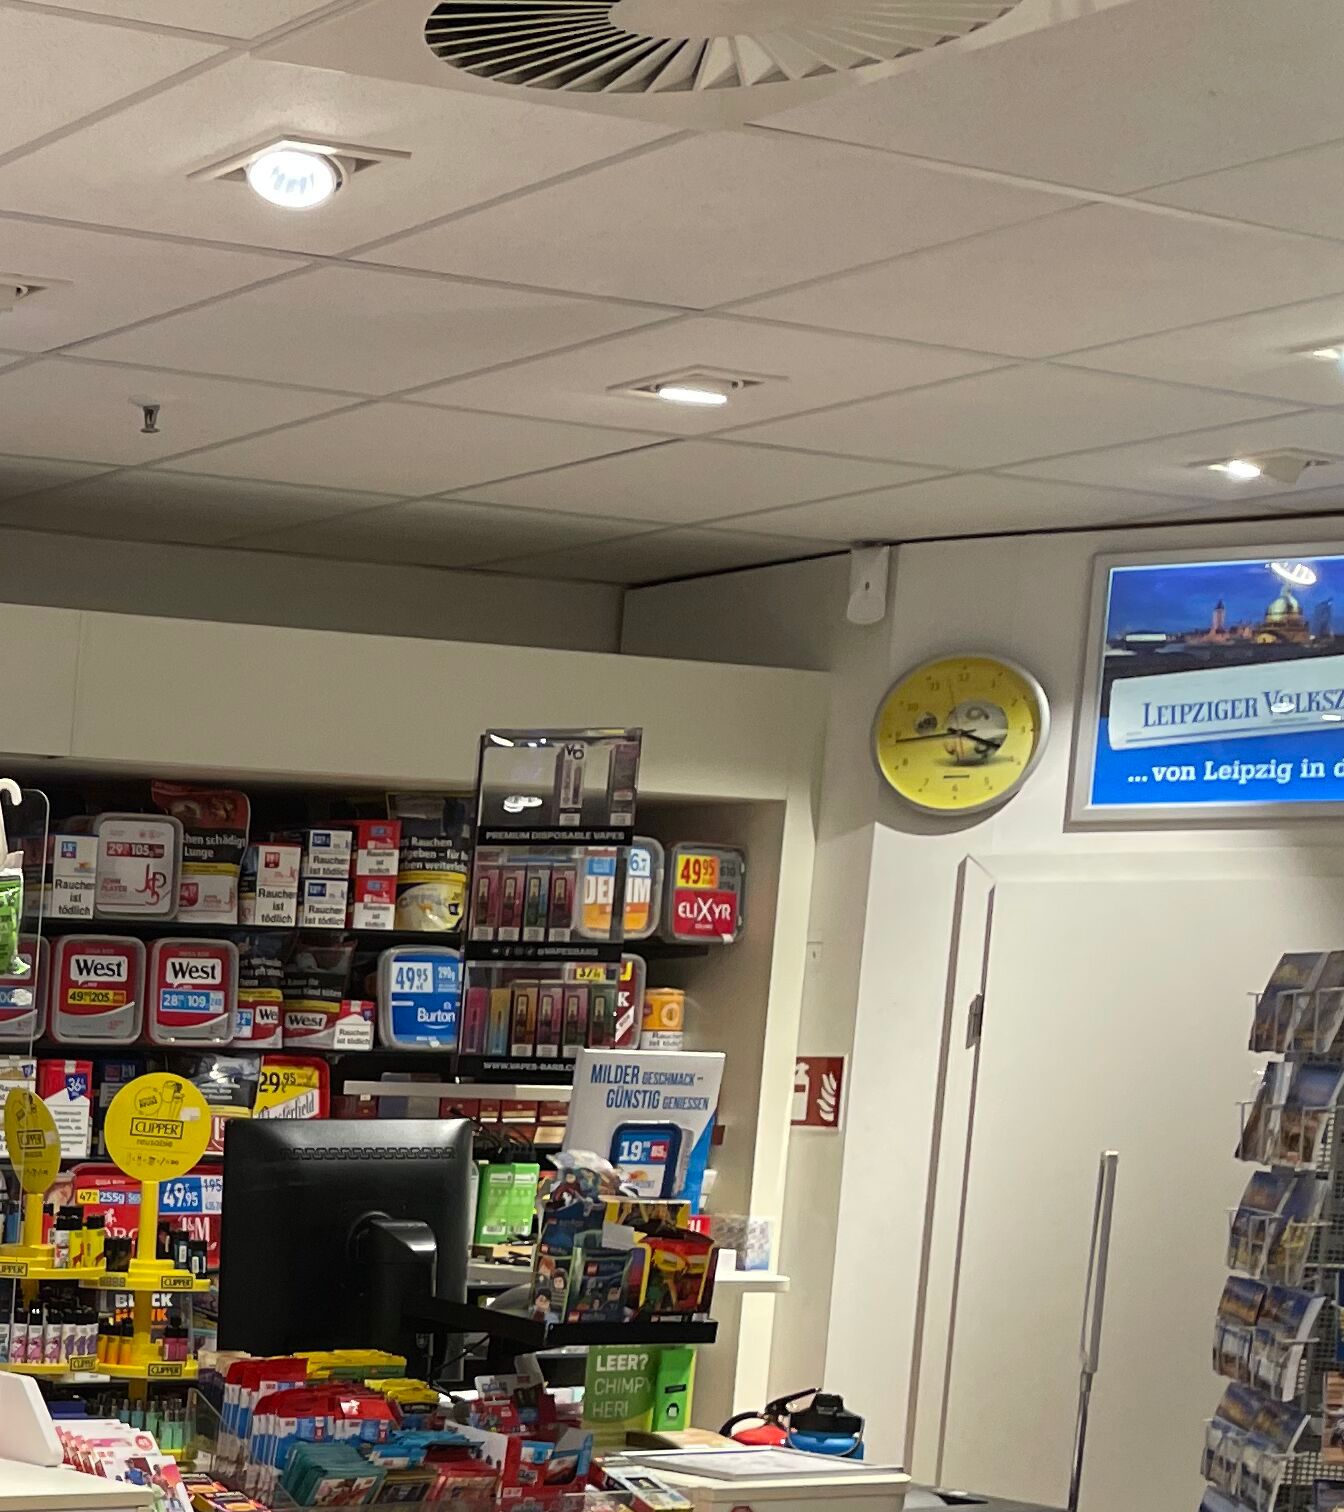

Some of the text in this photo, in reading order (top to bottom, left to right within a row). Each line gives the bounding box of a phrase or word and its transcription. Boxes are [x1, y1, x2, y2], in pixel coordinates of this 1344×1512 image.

[1143, 698, 1258, 728] LEIPZIGER
[1204, 759, 1293, 784] Leipzig
[1300, 758, 1325, 778] in
[486, 831, 625, 841] PREMIUM DISPOSABLE VAPES
[184, 846, 215, 858] Lunge
[70, 893, 82, 903] ist
[58, 903, 91, 916] tödlich
[272, 902, 284, 911] ist
[678, 896, 732, 922] ELIXYR
[261, 911, 293, 923] tödlich
[75, 958, 123, 977] West
[170, 960, 216, 980] West
[287, 1014, 324, 1027] West
[417, 1008, 456, 1024] Burton
[590, 1064, 641, 1085] MILDER
[606, 1086, 710, 1111] GÜNSTIG GENIESSEN
[134, 1120, 180, 1137] CLIPPER
[162, 1277, 193, 1288] CLIPPER
[151, 1365, 181, 1375] CLIPPER
[596, 1354, 649, 1372] LEER?
[594, 1377, 654, 1396] CHIMPY
